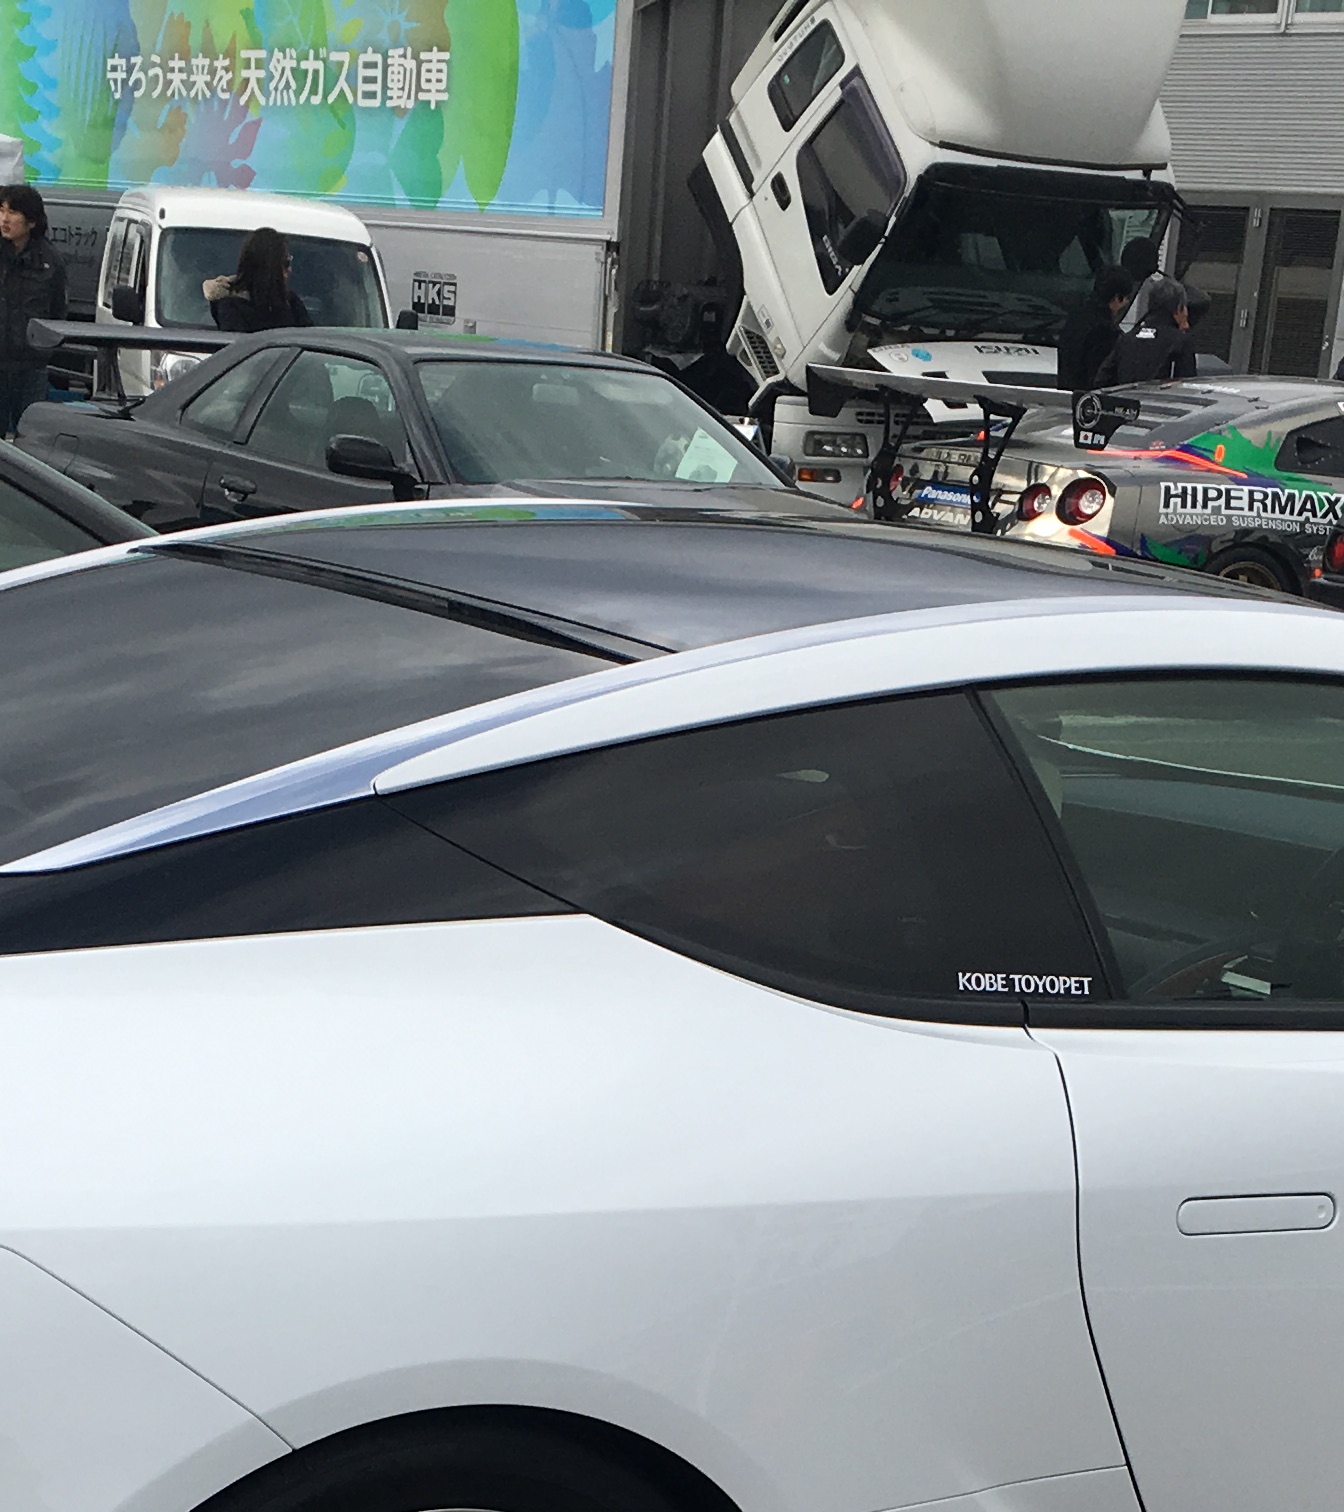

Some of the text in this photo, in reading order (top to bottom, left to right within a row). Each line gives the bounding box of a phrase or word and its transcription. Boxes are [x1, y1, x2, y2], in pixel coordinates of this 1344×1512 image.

[106, 46, 451, 111] 守ろう未来を 天然ガス自動車
[413, 281, 456, 309] HKS
[907, 507, 972, 525] ADVAN
[1159, 514, 1336, 536] ADVANCED SUSPENSION SYST
[958, 972, 1093, 995] KOBE TOYOPET
